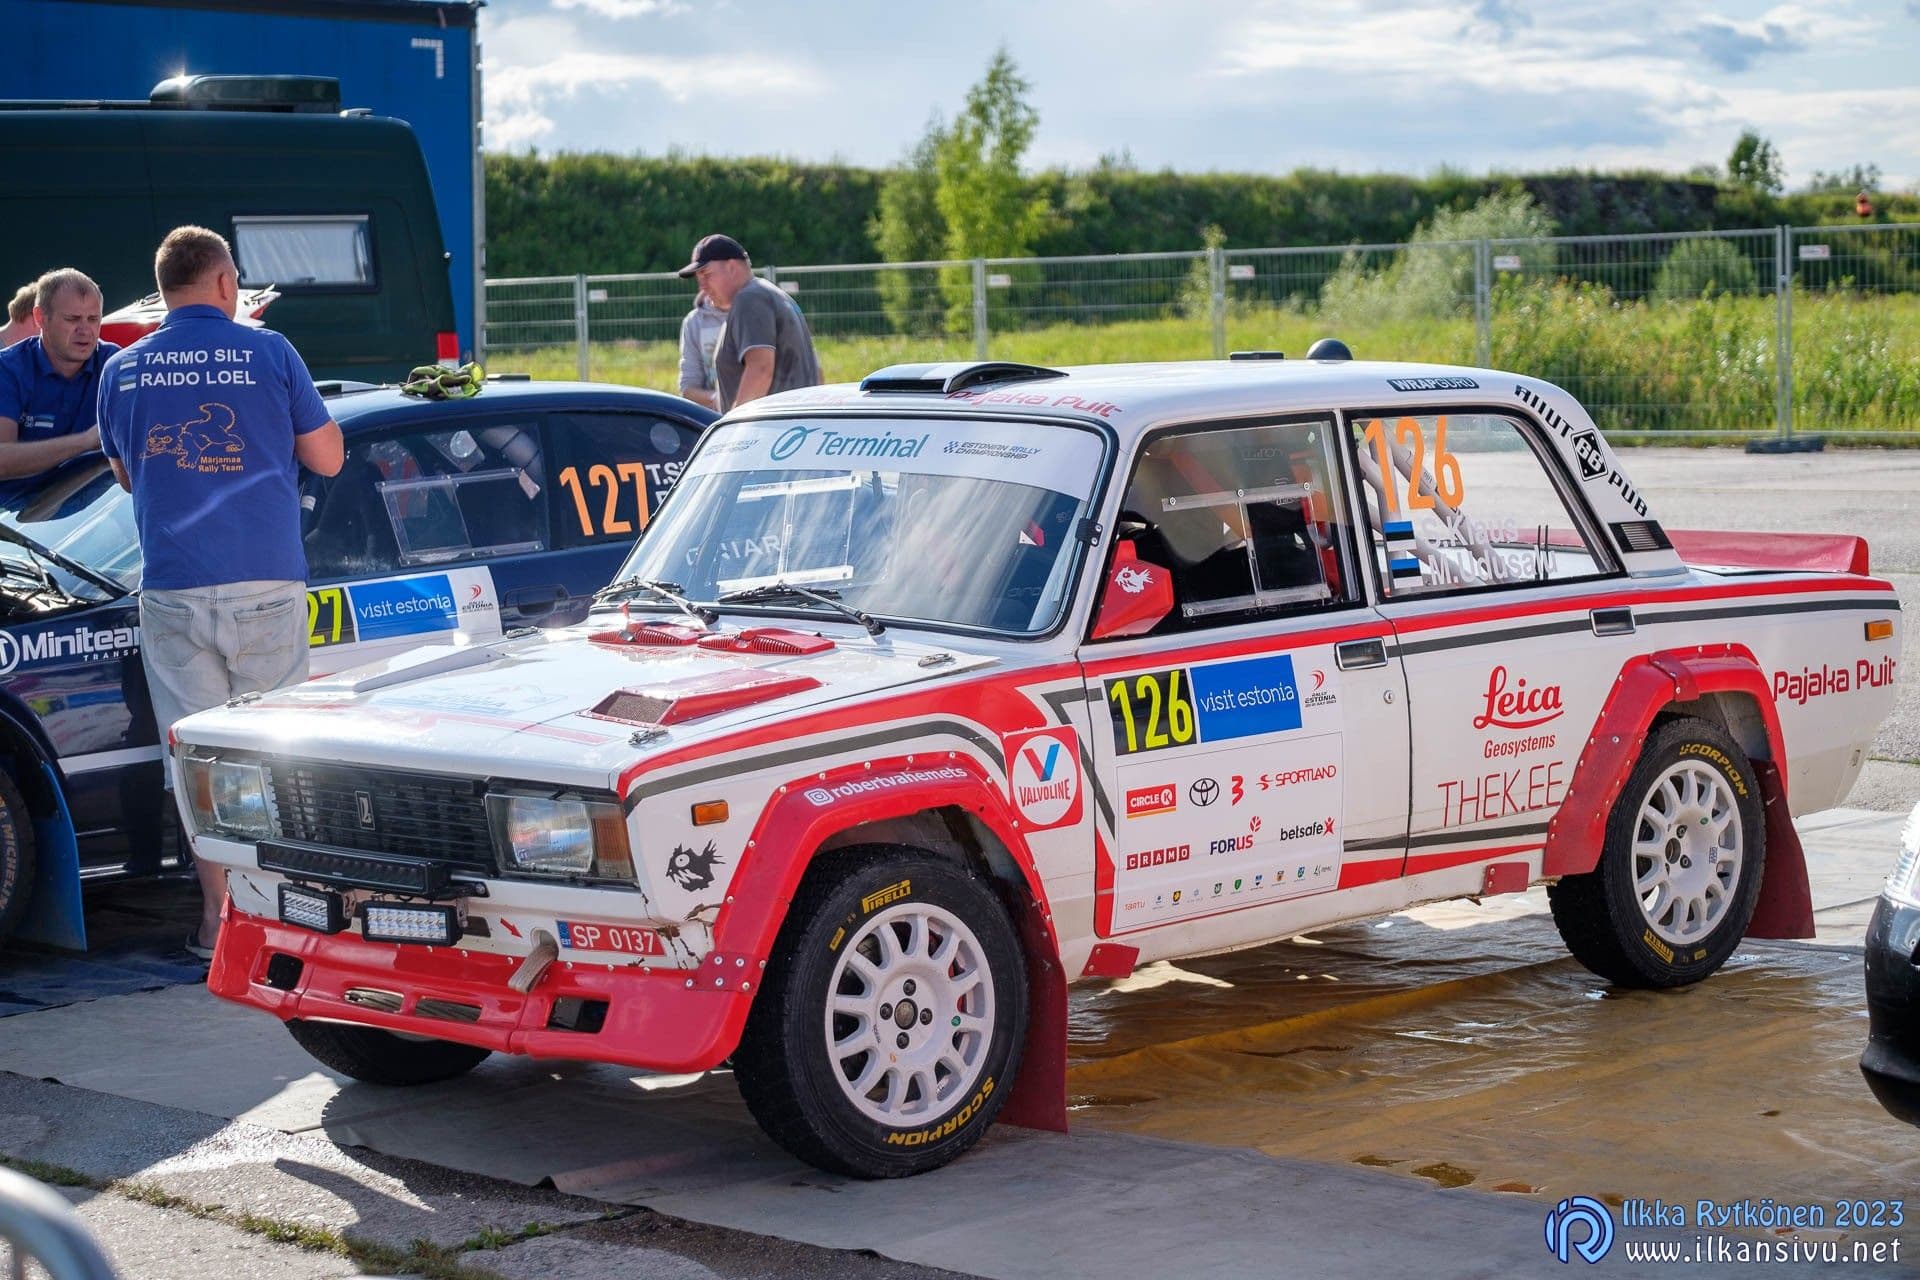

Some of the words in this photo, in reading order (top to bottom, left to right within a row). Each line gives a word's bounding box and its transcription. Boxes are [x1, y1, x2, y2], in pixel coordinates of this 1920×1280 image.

[144, 351, 208, 365] TARMO
[214, 349, 253, 362] SILT
[140, 372, 200, 386] RAIDO
[206, 370, 256, 385] LOEL
[1051, 395, 1123, 417] Puit
[816, 431, 930, 458] Terminal
[955, 448, 1028, 459] CHAMPIONSHIP
[961, 441, 1011, 451] ESTONIAN
[1009, 446, 1042, 455] RALLY
[198, 464, 218, 474] Rally
[221, 464, 244, 472] Team
[1364, 415, 1464, 513] 126
[1575, 437, 1604, 472] 66
[1608, 470, 1648, 517] PUB
[559, 462, 649, 536] 127
[359, 601, 394, 619] visit
[395, 593, 451, 615] estonia
[1774, 664, 1850, 705] Pajaka
[1856, 655, 1896, 690] Puit
[1110, 669, 1194, 752] 126
[1200, 690, 1236, 713] visit
[1237, 681, 1295, 707] estonia
[1304, 694, 1337, 704] ESTONIA
[1473, 665, 1564, 729] Leica
[1484, 734, 1556, 758] Geosystems
[830, 767, 968, 798] robertvahemets
[1275, 765, 1337, 787] SPORTLAND
[1680, 743, 1748, 796] SCORPION
[1018, 778, 1071, 807] VALVOLINE
[1130, 793, 1160, 808] CIRCLE
[1437, 761, 1563, 828] THEK.EE
[1280, 821, 1324, 841] betsafe
[1128, 848, 1188, 868] CRAMO
[1209, 834, 1254, 856] FORUS
[862, 880, 911, 914] PIRELLI
[573, 925, 601, 948] SP
[609, 928, 654, 953] 0137
[887, 1076, 995, 1146] SCORPION
